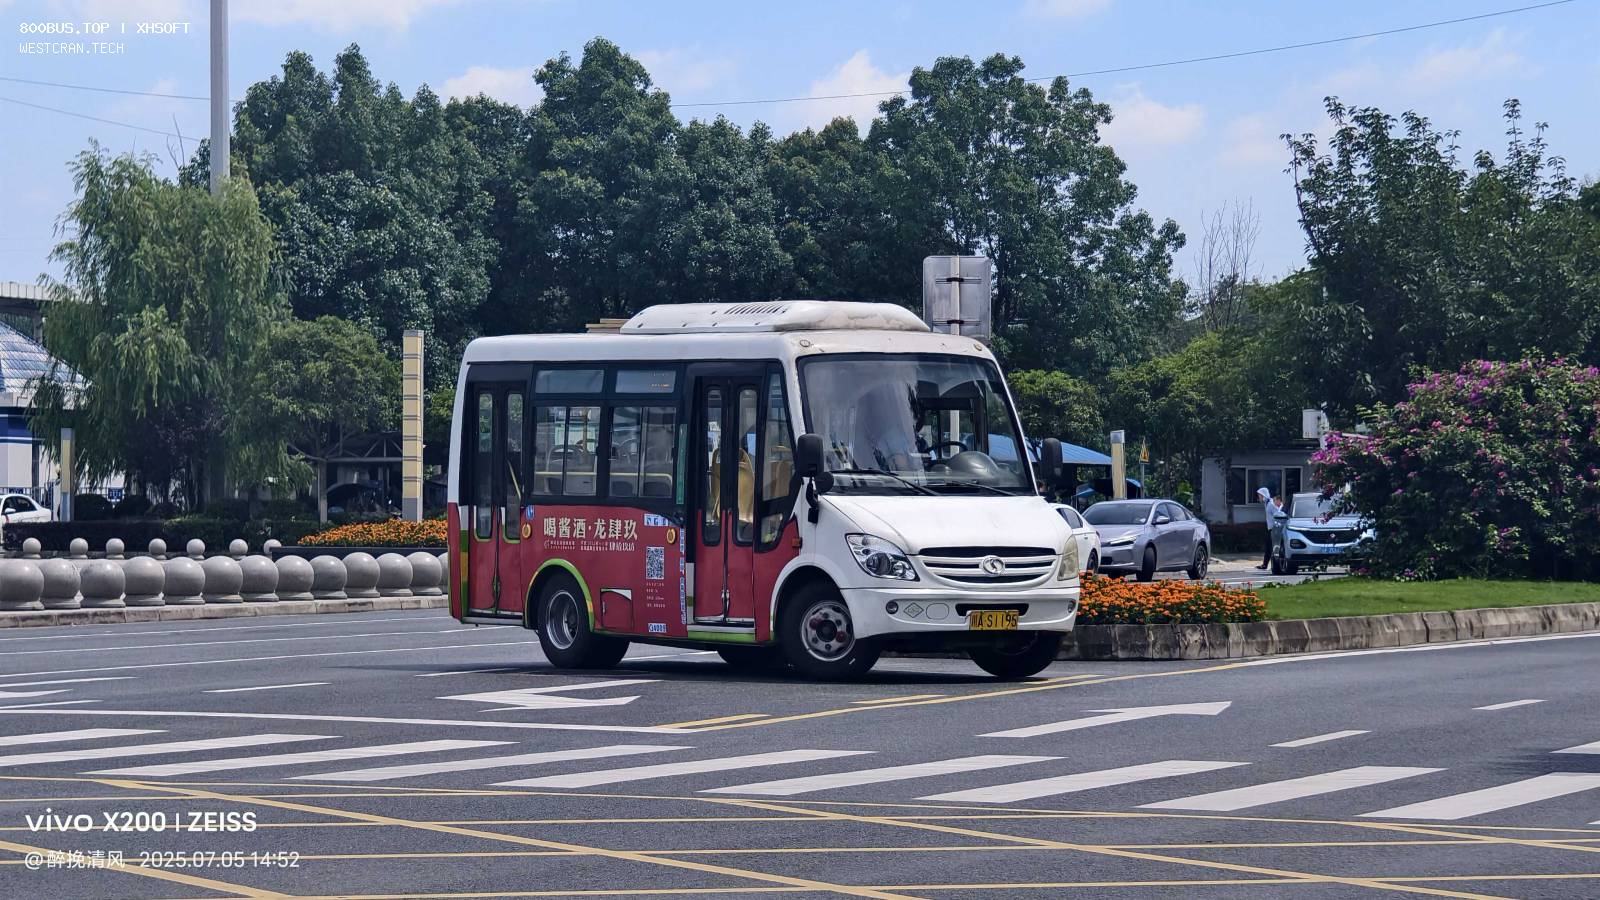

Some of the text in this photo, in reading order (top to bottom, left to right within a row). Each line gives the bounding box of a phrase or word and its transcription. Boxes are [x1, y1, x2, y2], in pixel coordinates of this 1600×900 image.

[543, 517, 638, 540] 喝酱酒·龙肆玖
